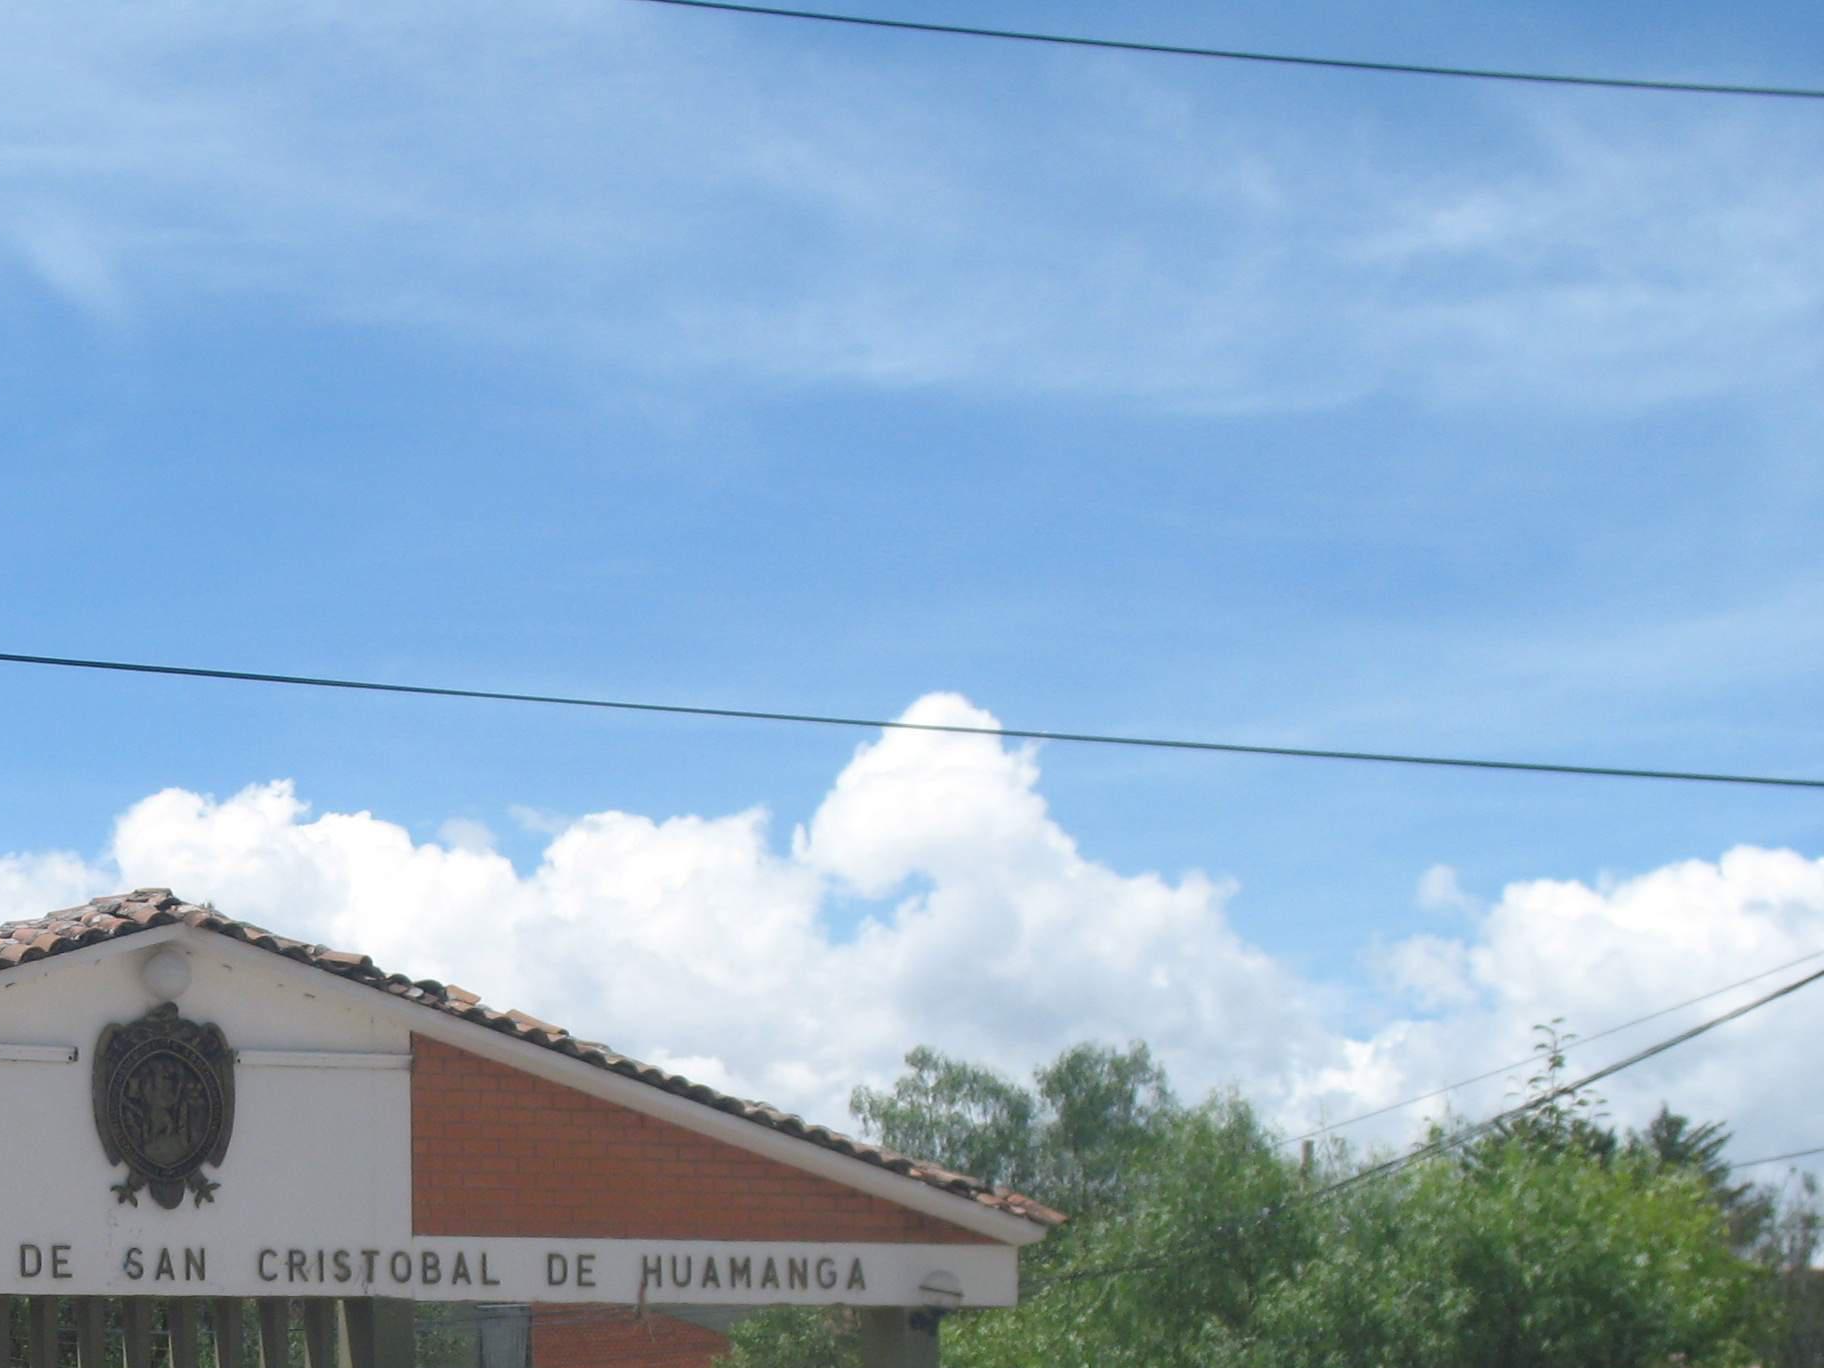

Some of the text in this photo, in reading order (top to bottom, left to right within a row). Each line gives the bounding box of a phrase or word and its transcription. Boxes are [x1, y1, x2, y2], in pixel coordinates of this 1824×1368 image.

[19, 1244, 73, 1279] DE
[125, 1247, 206, 1282] SAN
[257, 1248, 500, 1287] CRISTOBAL
[547, 1253, 597, 1288] DE
[642, 1255, 867, 1291] HUAMANGA
